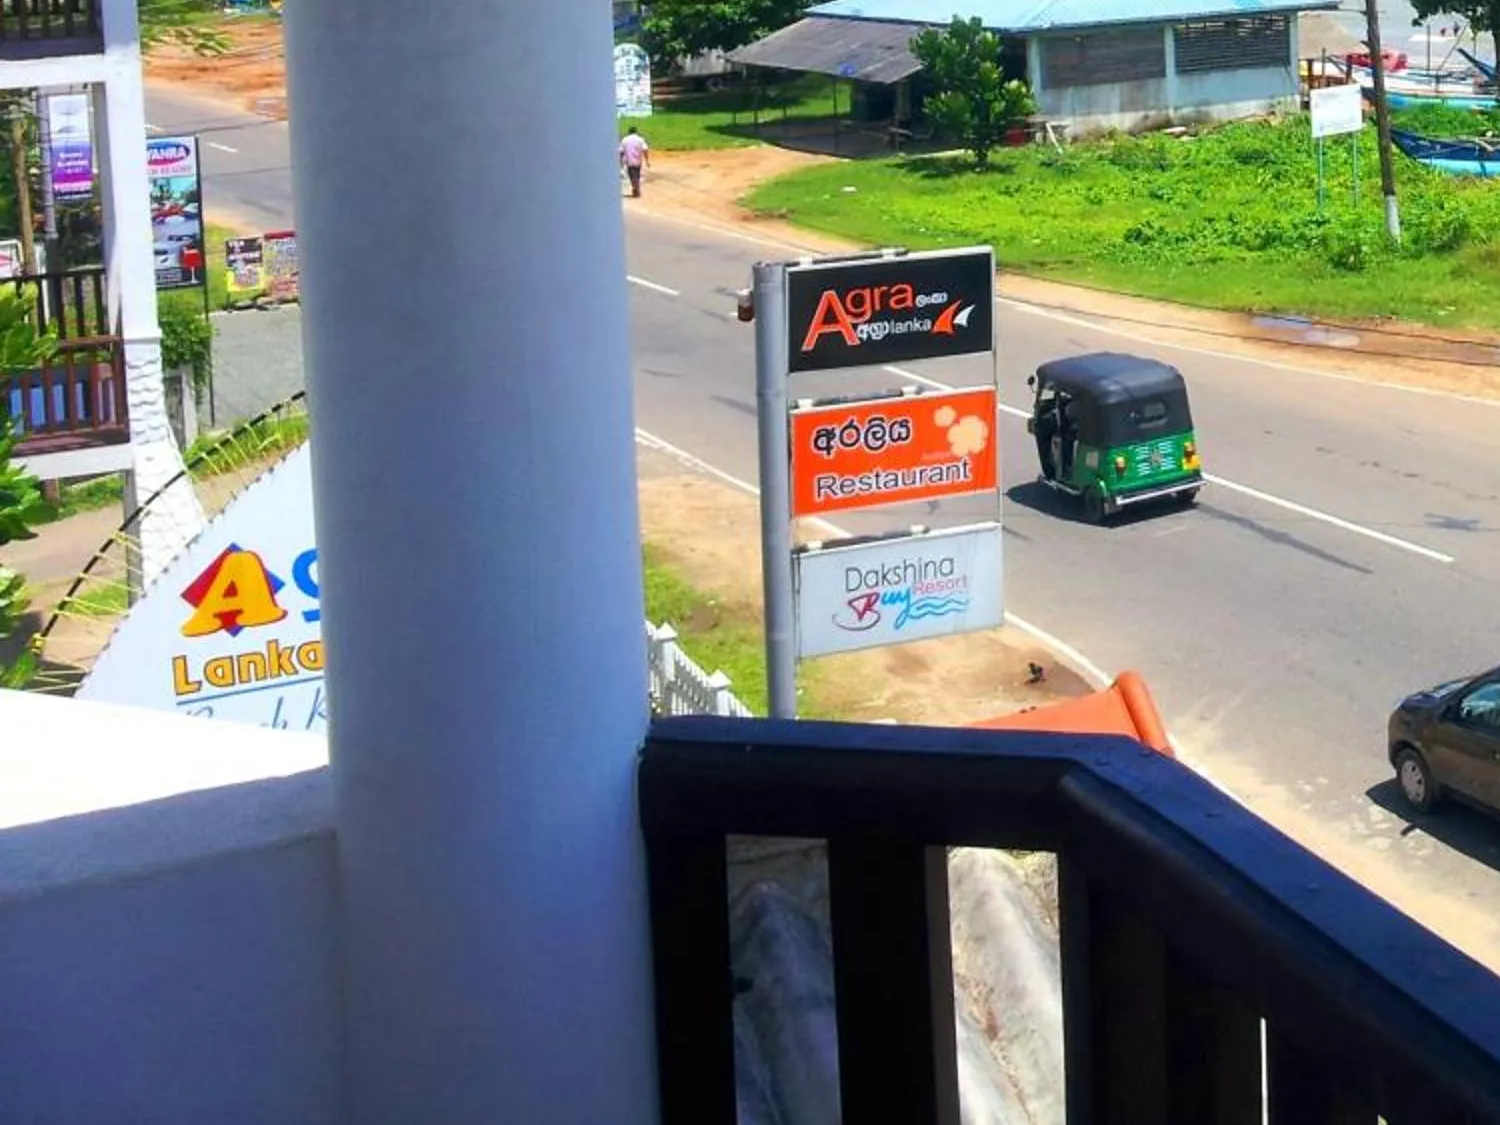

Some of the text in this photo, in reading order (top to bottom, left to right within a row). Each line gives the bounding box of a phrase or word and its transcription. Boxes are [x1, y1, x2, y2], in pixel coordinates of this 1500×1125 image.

[801, 282, 915, 352] Agra
[815, 457, 972, 501] Restaurant
[844, 556, 956, 593] Dakshina
[913, 573, 970, 596] Resort
